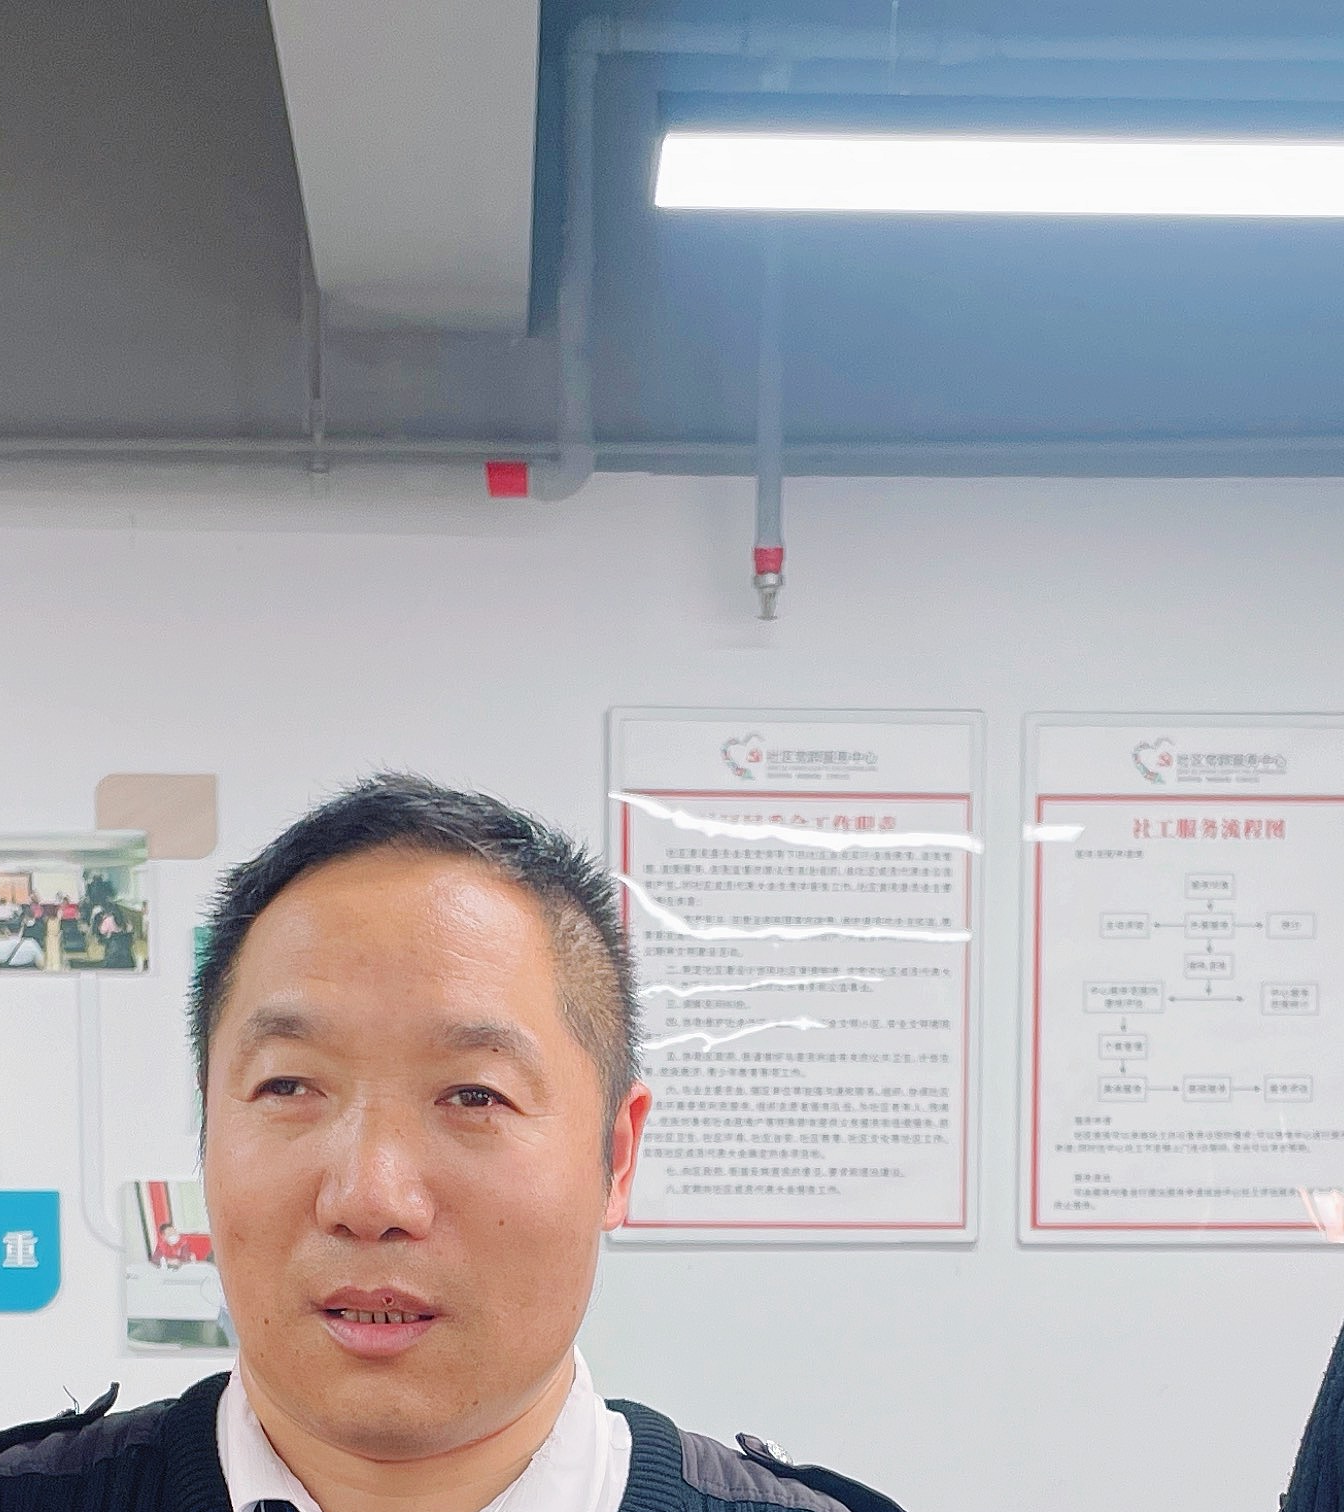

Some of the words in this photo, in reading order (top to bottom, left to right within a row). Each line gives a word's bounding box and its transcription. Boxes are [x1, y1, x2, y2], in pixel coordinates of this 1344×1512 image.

[1132, 817, 1287, 841] 社工服务流程图
